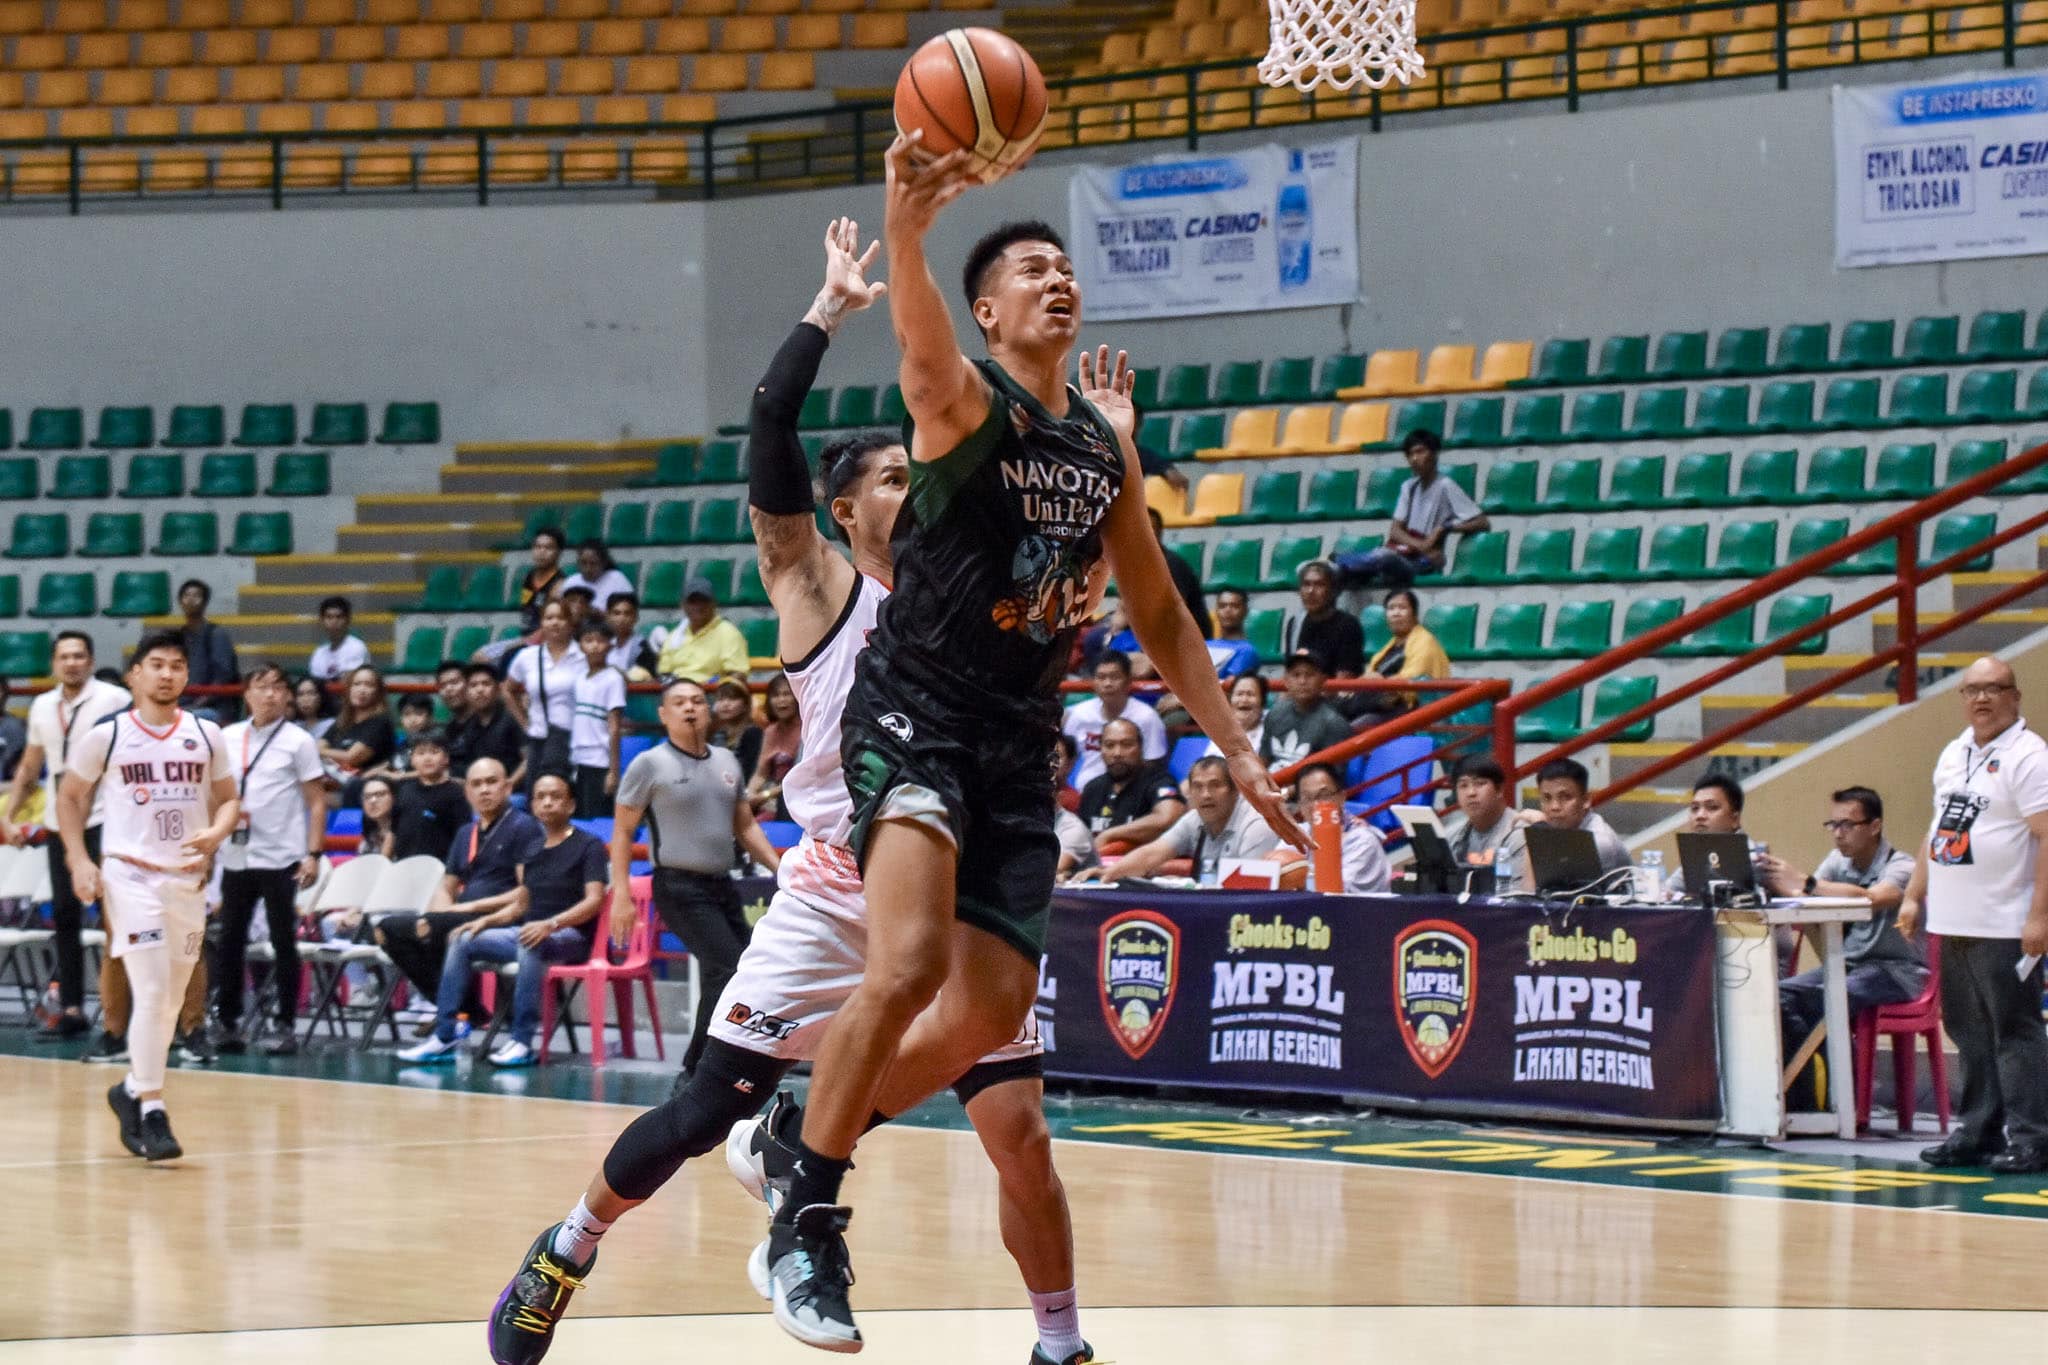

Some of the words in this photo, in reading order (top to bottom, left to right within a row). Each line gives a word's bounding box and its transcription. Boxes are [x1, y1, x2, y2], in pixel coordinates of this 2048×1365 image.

[1867, 150, 1906, 179] ETHYL
[1911, 145, 1970, 174] ALCOHOL
[1879, 178, 1960, 211] TRICLOSAN
[1185, 212, 1260, 238] CASINO
[155, 809, 184, 841] 18
[1110, 959, 1165, 981] MPBL
[1406, 972, 1463, 996] MPBL
[1211, 961, 1344, 1014] MPBL
[1514, 975, 1653, 1032] MPBL
[1210, 1029, 1270, 1063] LAKAN
[1273, 1030, 1342, 1069] SEASON
[1514, 1047, 1578, 1082] LAKAN
[1581, 1047, 1654, 1090] SEASON
[1072, 1121, 1994, 1192] ALONTE
